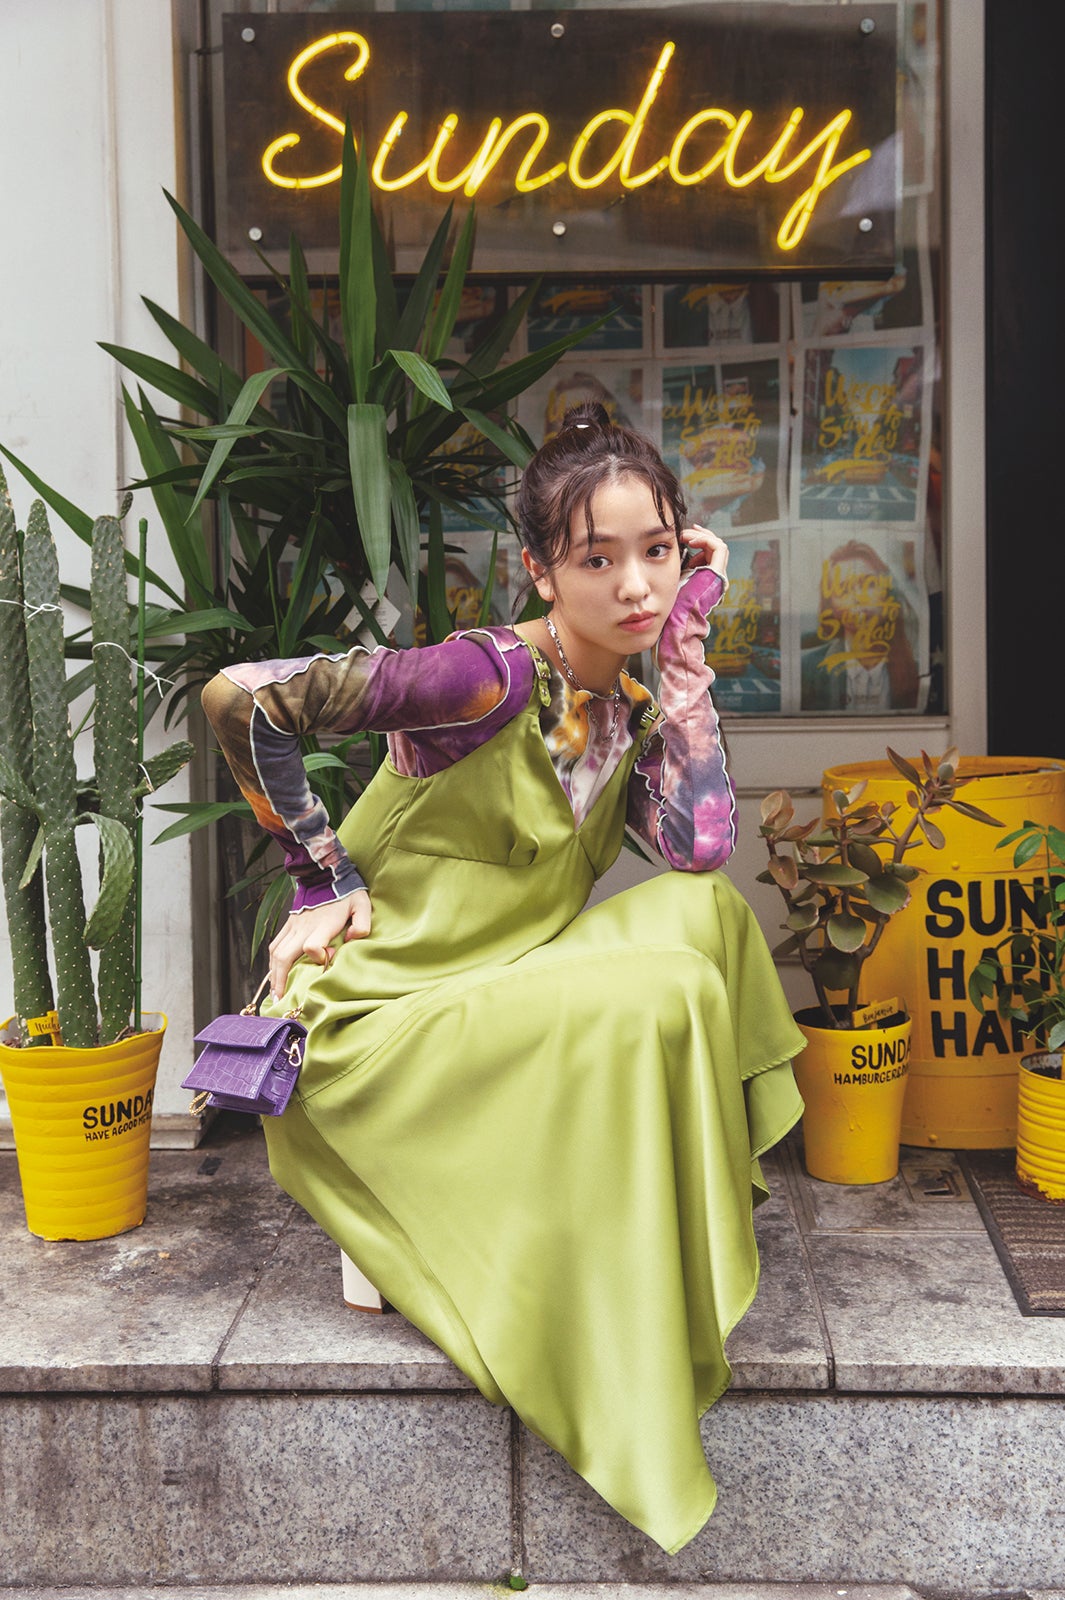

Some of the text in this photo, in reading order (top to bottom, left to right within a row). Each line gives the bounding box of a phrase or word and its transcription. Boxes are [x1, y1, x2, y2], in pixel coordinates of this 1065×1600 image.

[262, 31, 871, 250] Sunday
[83, 1088, 154, 1129] SUNDA
[85, 1129, 110, 1142] HAVE
